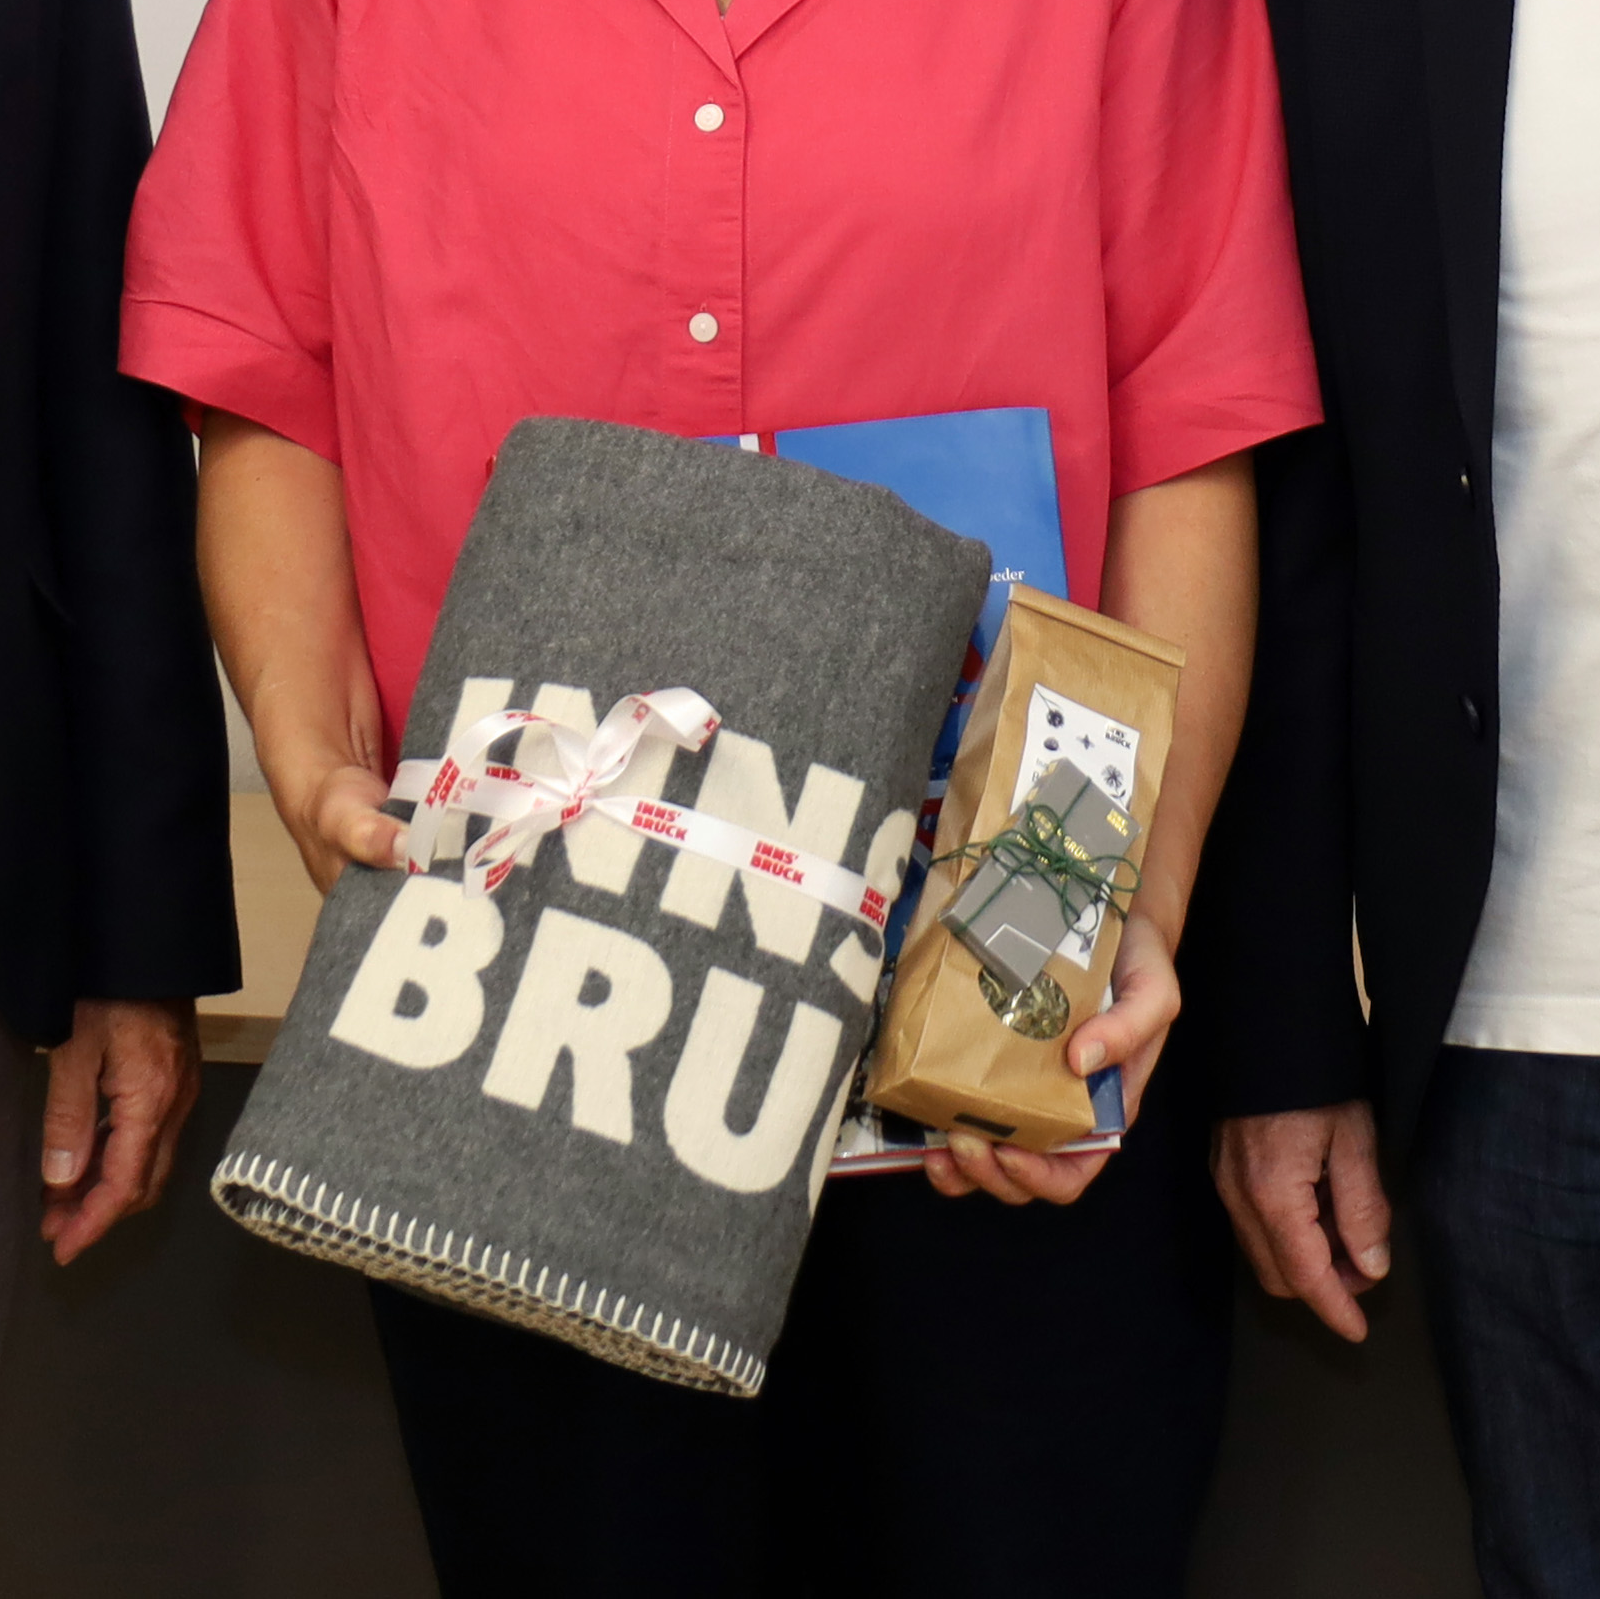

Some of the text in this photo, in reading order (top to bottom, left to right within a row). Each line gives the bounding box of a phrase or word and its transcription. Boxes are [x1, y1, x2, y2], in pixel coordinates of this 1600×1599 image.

[636, 800, 682, 822] INNS'
[631, 816, 688, 841] BRUCK
[754, 840, 799, 864] INNS'
[750, 854, 805, 885] BRUCK
